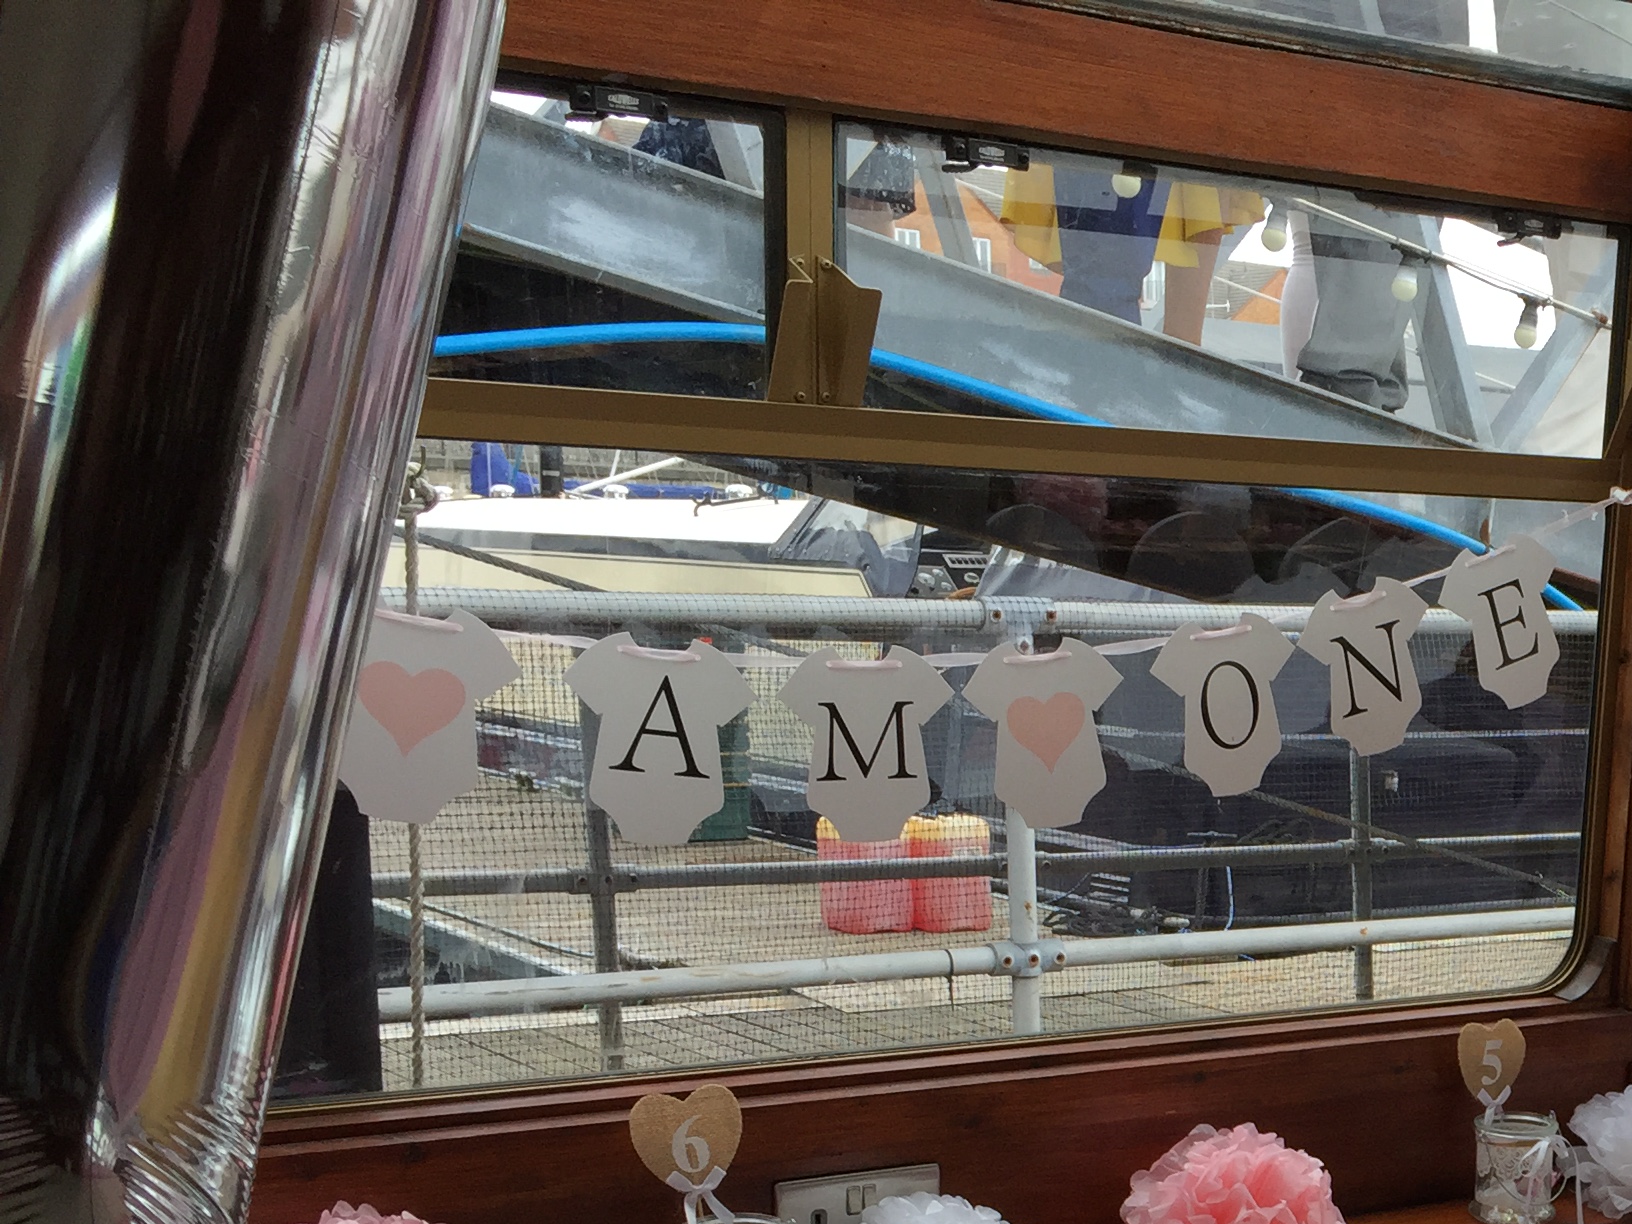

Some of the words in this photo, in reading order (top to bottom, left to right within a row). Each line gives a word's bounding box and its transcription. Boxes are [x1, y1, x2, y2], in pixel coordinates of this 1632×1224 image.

[1200, 578, 1540, 751] ONE
[1481, 1039, 1503, 1086] 5
[671, 1115, 711, 1173] 6
